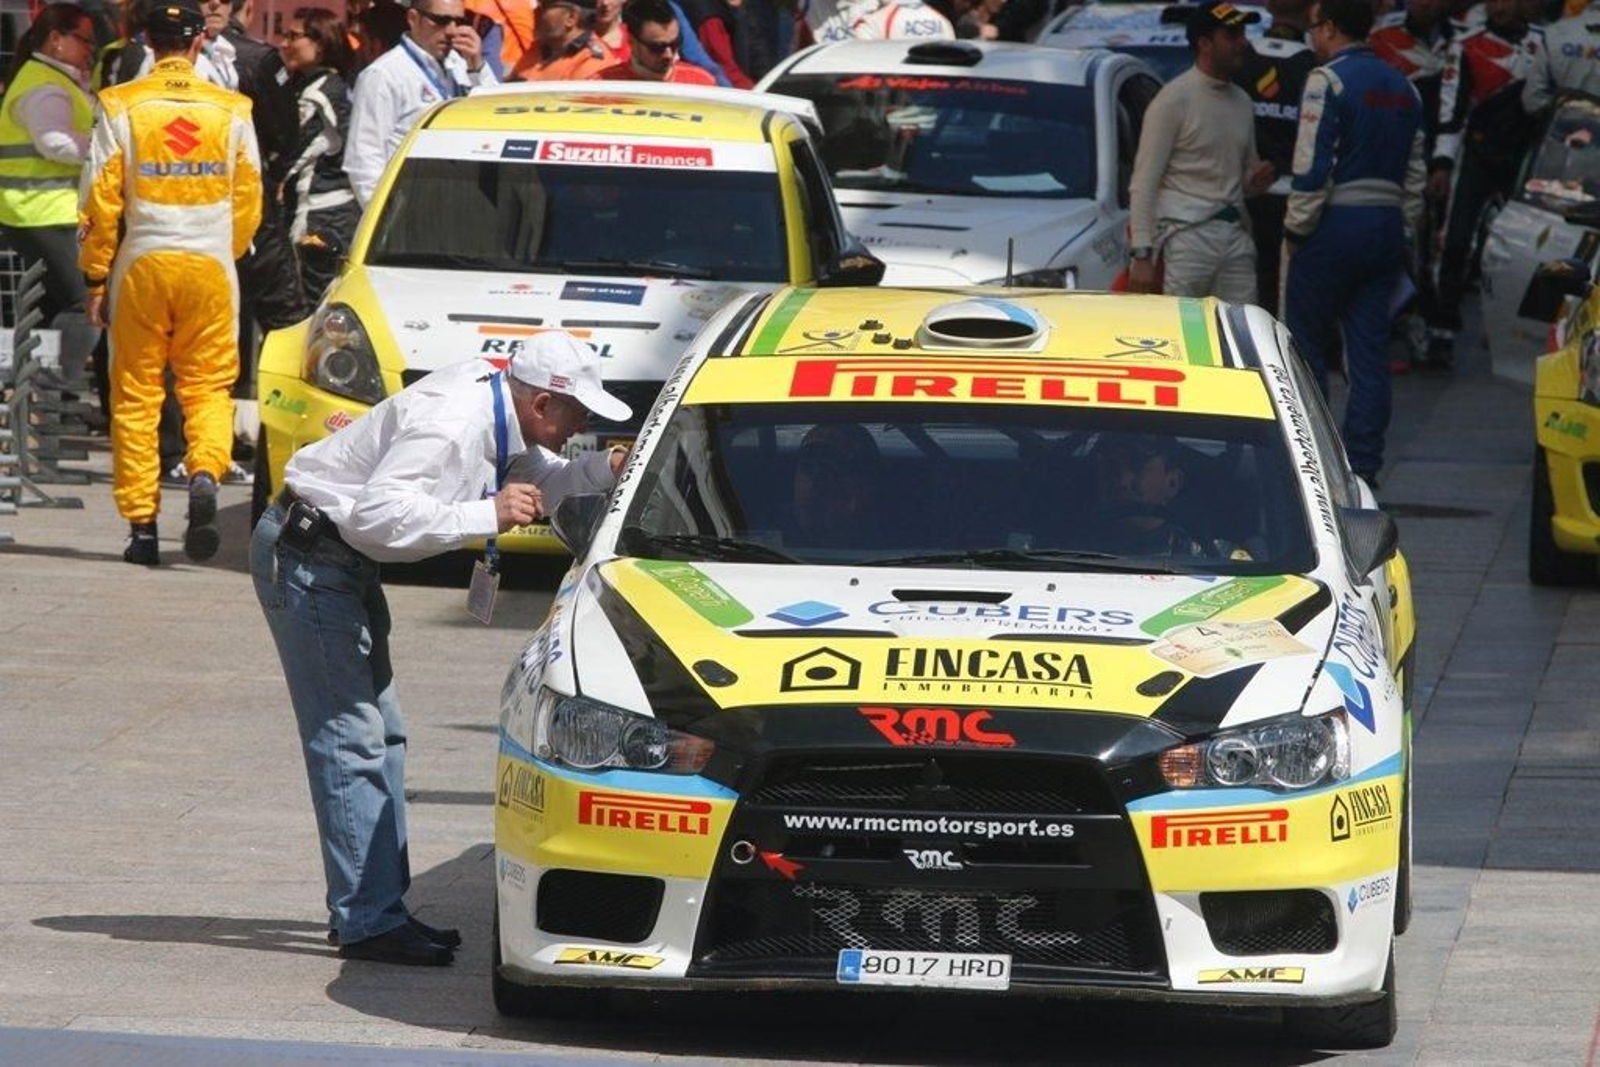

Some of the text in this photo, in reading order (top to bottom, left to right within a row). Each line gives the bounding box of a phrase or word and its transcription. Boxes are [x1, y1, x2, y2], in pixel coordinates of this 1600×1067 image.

[493, 105, 704, 123] SUZUKI
[546, 142, 707, 167] Suzuki Finance
[139, 161, 227, 177] SUZUKI
[788, 358, 1186, 408] PIRELLI
[867, 600, 1134, 626] CUBERS
[885, 647, 1093, 685] FINCASA
[883, 682, 1094, 700] INMOBILIARIA
[578, 790, 713, 836] PIRELLI
[1348, 783, 1393, 823] FINCASA
[784, 814, 1075, 840] www.rmcmotorsport.es
[1151, 808, 1290, 849] PIRELLI
[863, 955, 940, 977] 9017
